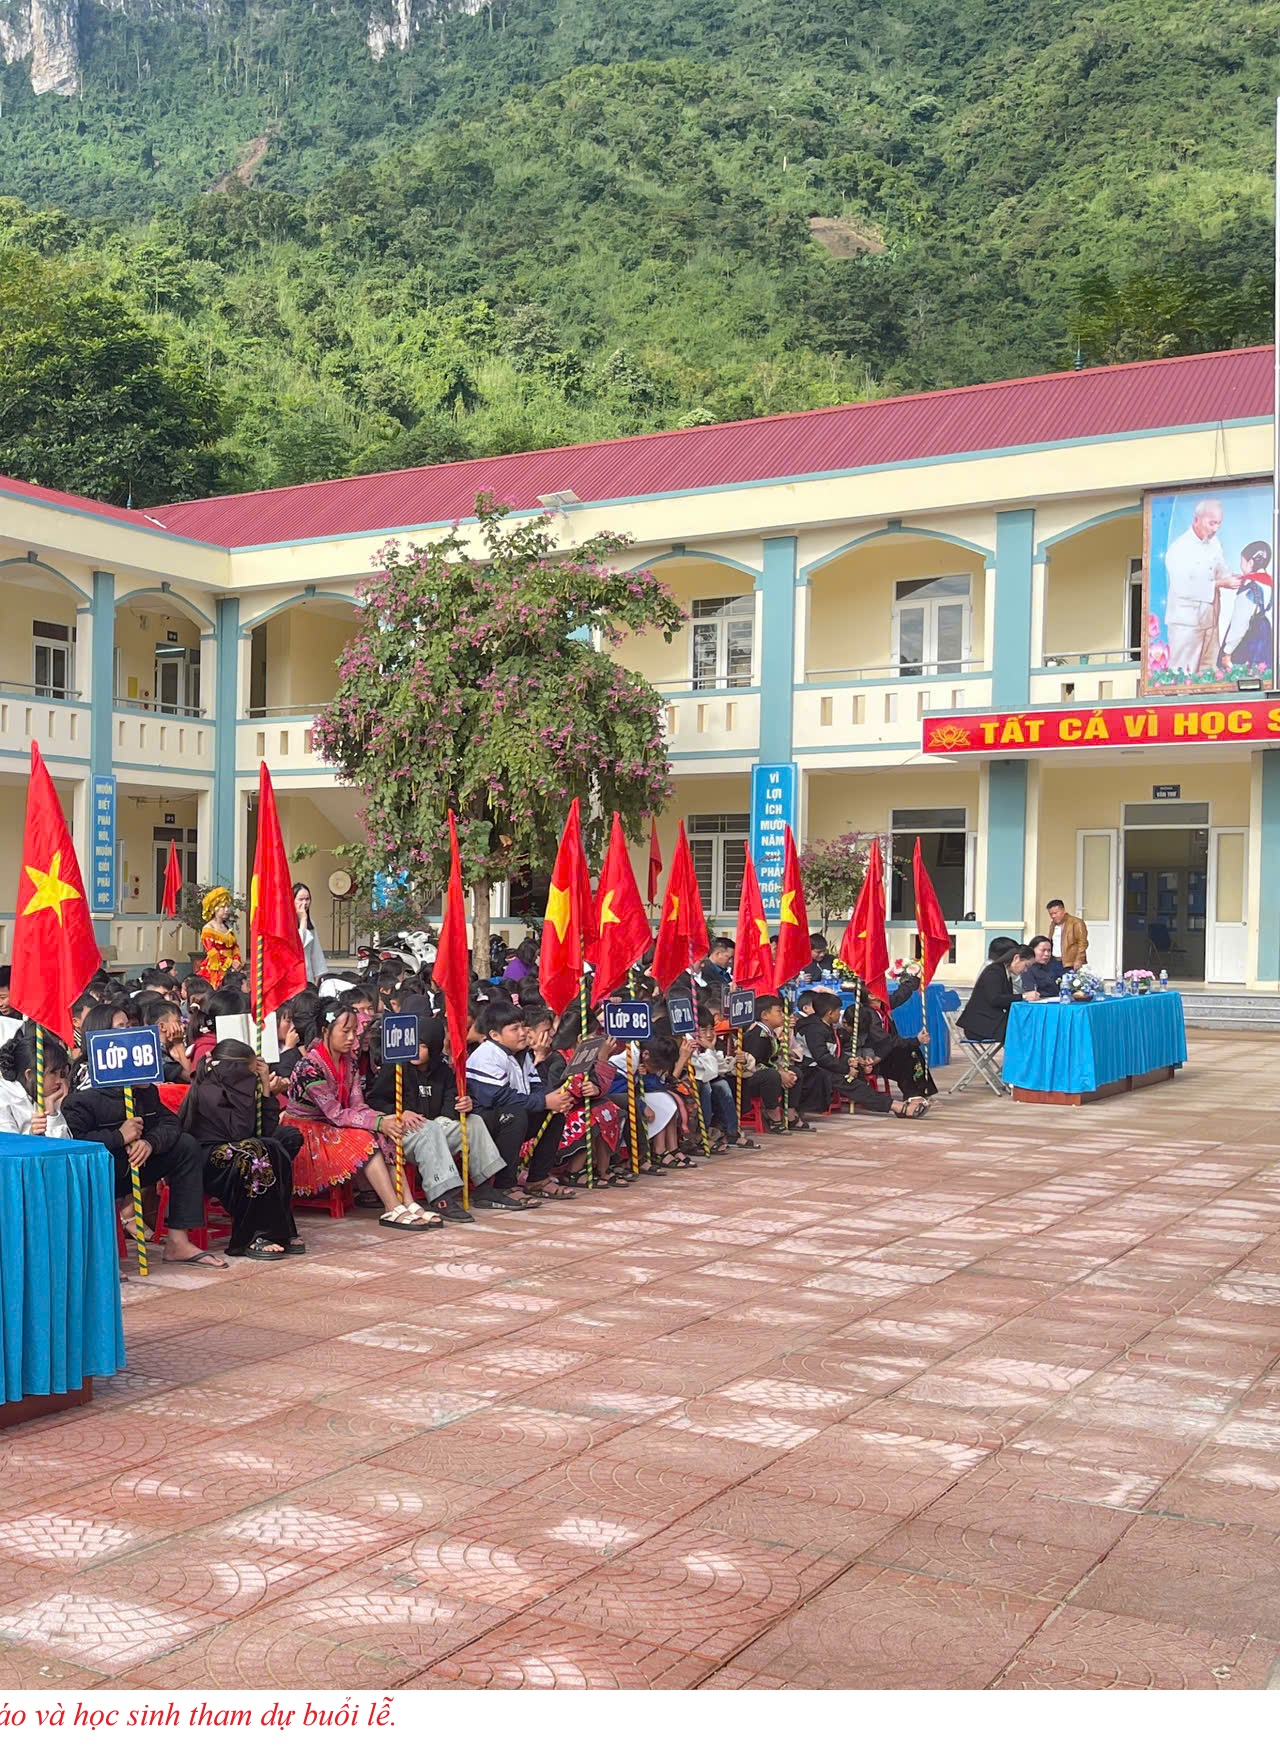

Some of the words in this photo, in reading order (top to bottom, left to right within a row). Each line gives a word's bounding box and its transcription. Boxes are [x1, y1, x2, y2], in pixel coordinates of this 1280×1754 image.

[980, 714, 1045, 745] TẤT
[1058, 709, 1110, 742] CẢ
[1123, 709, 1159, 738] VÌ
[1173, 710, 1253, 739] HỌC
[769, 771, 779, 783] VÌ
[767, 788, 782, 801] LỢI
[765, 803, 782, 815] ÍCH
[761, 833, 784, 847] NĂM
[732, 999, 743, 1017] LỚP
[609, 1008, 630, 1029] LỚP
[632, 1012, 647, 1029] 8C
[386, 1023, 402, 1048] LỚP
[404, 1027, 416, 1047] 8A
[96, 1041, 128, 1070] LỚP
[131, 1044, 154, 1067] 9B
